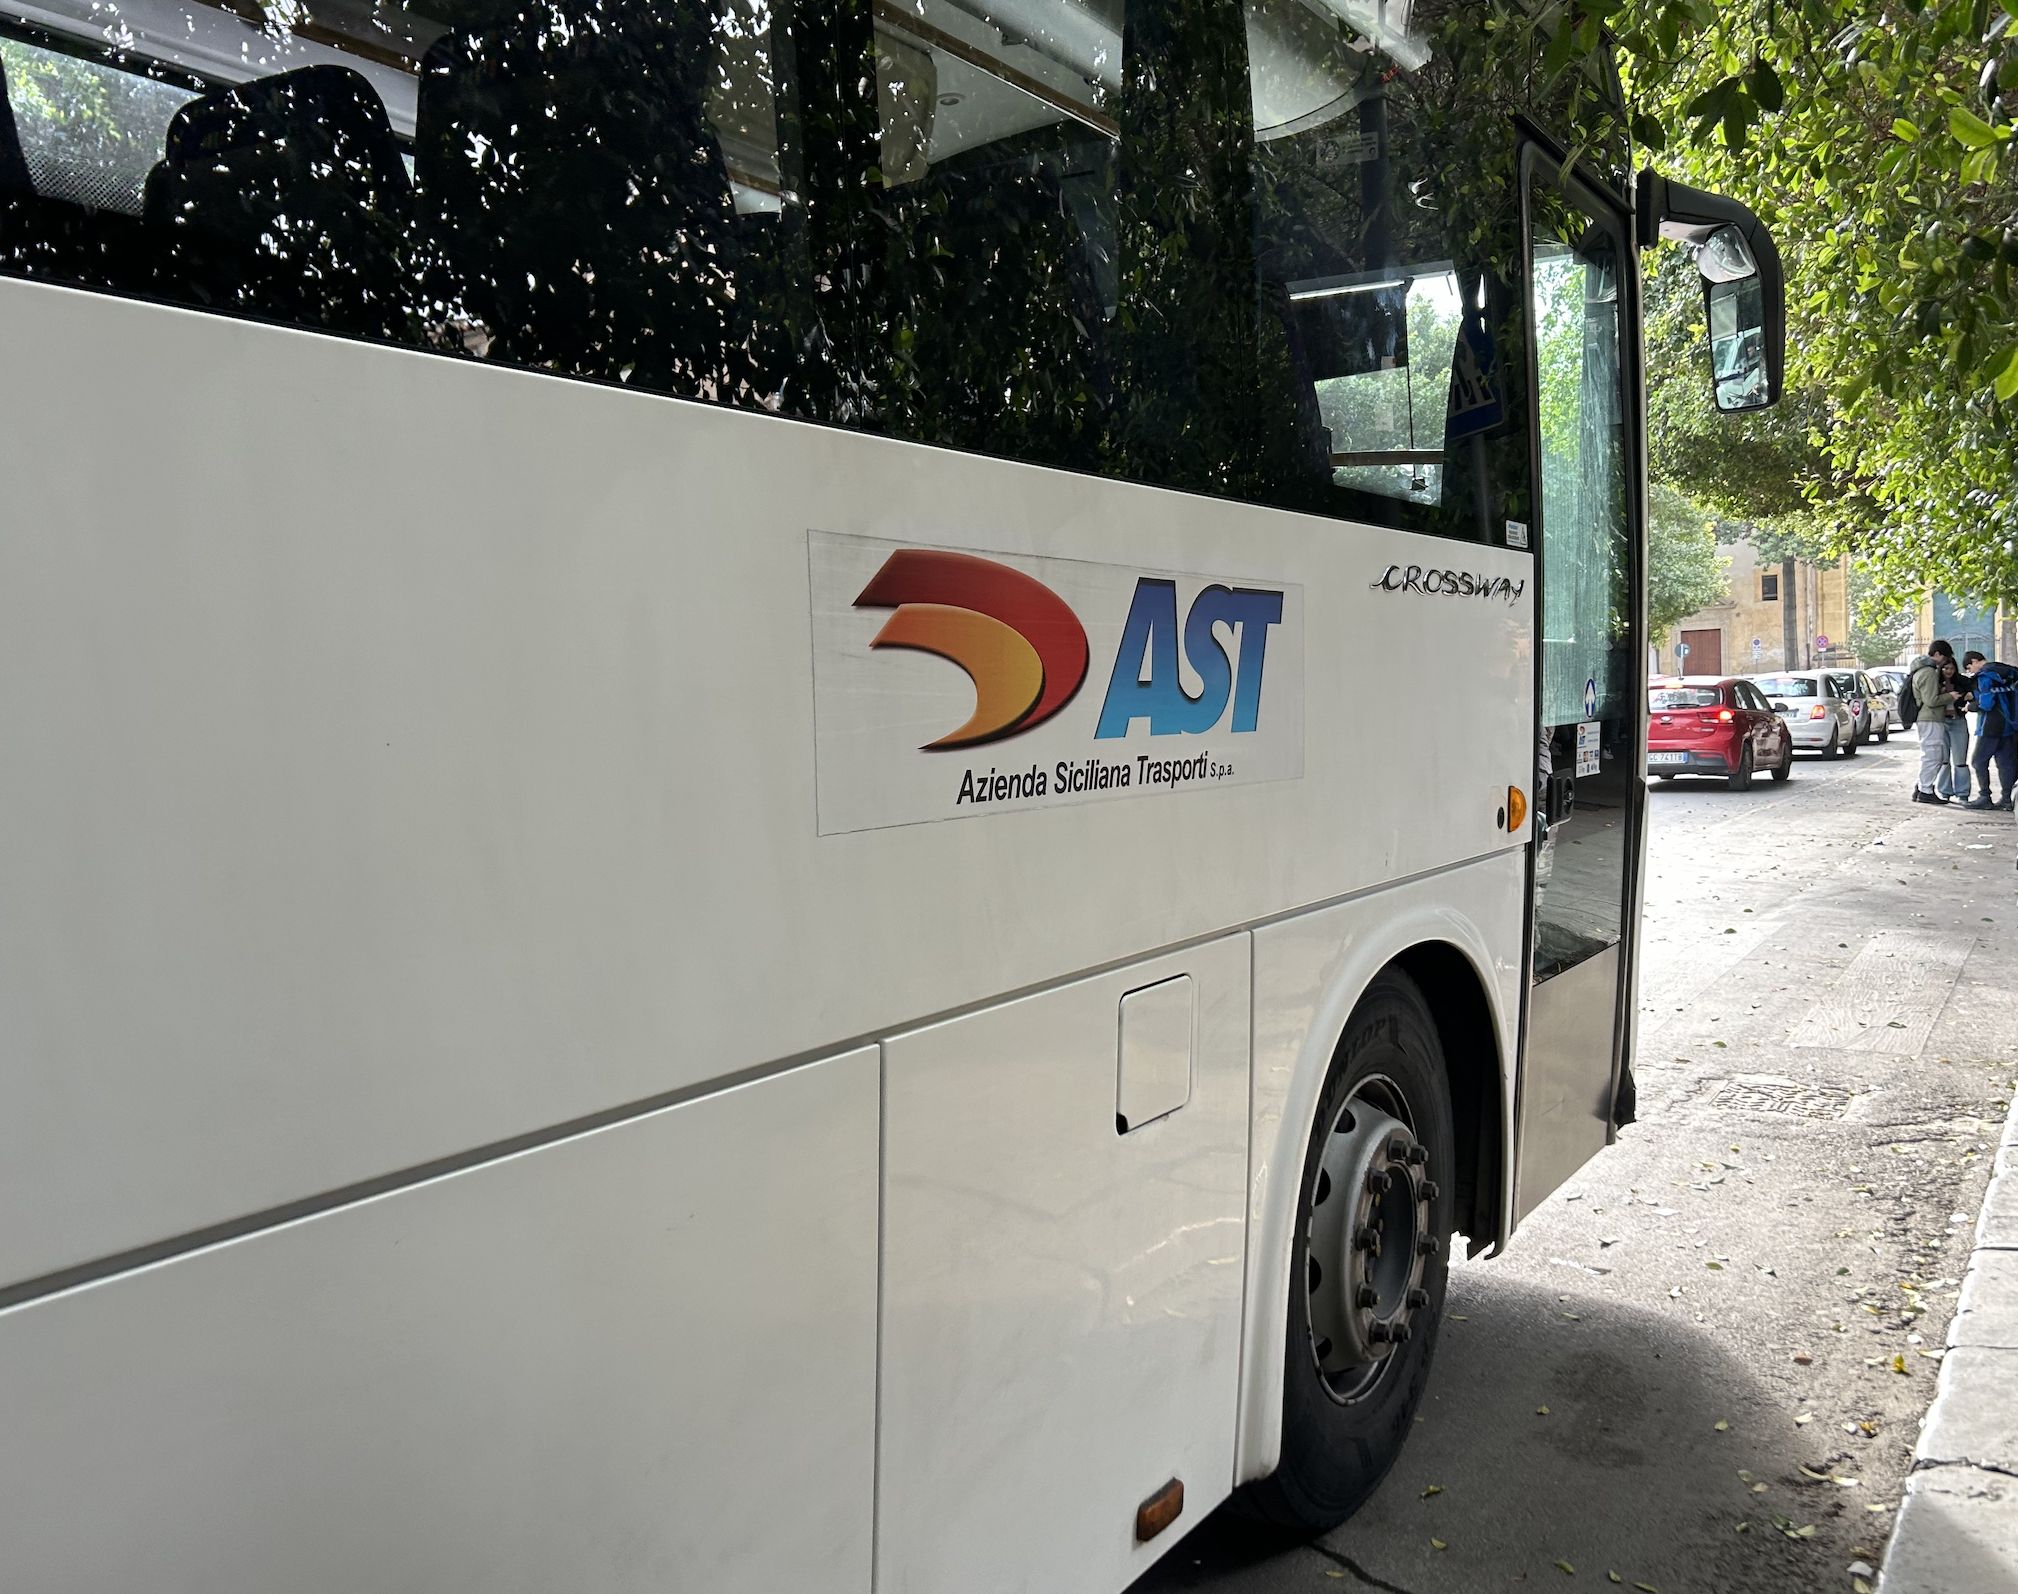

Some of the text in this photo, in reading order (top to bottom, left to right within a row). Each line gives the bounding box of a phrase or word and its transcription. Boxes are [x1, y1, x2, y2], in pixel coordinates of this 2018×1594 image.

[1369, 565, 1525, 608] CROSSWAY
[1094, 576, 1285, 740] AST
[956, 750, 1235, 804] Azienda Siciliana Trasporti S.p.a.
